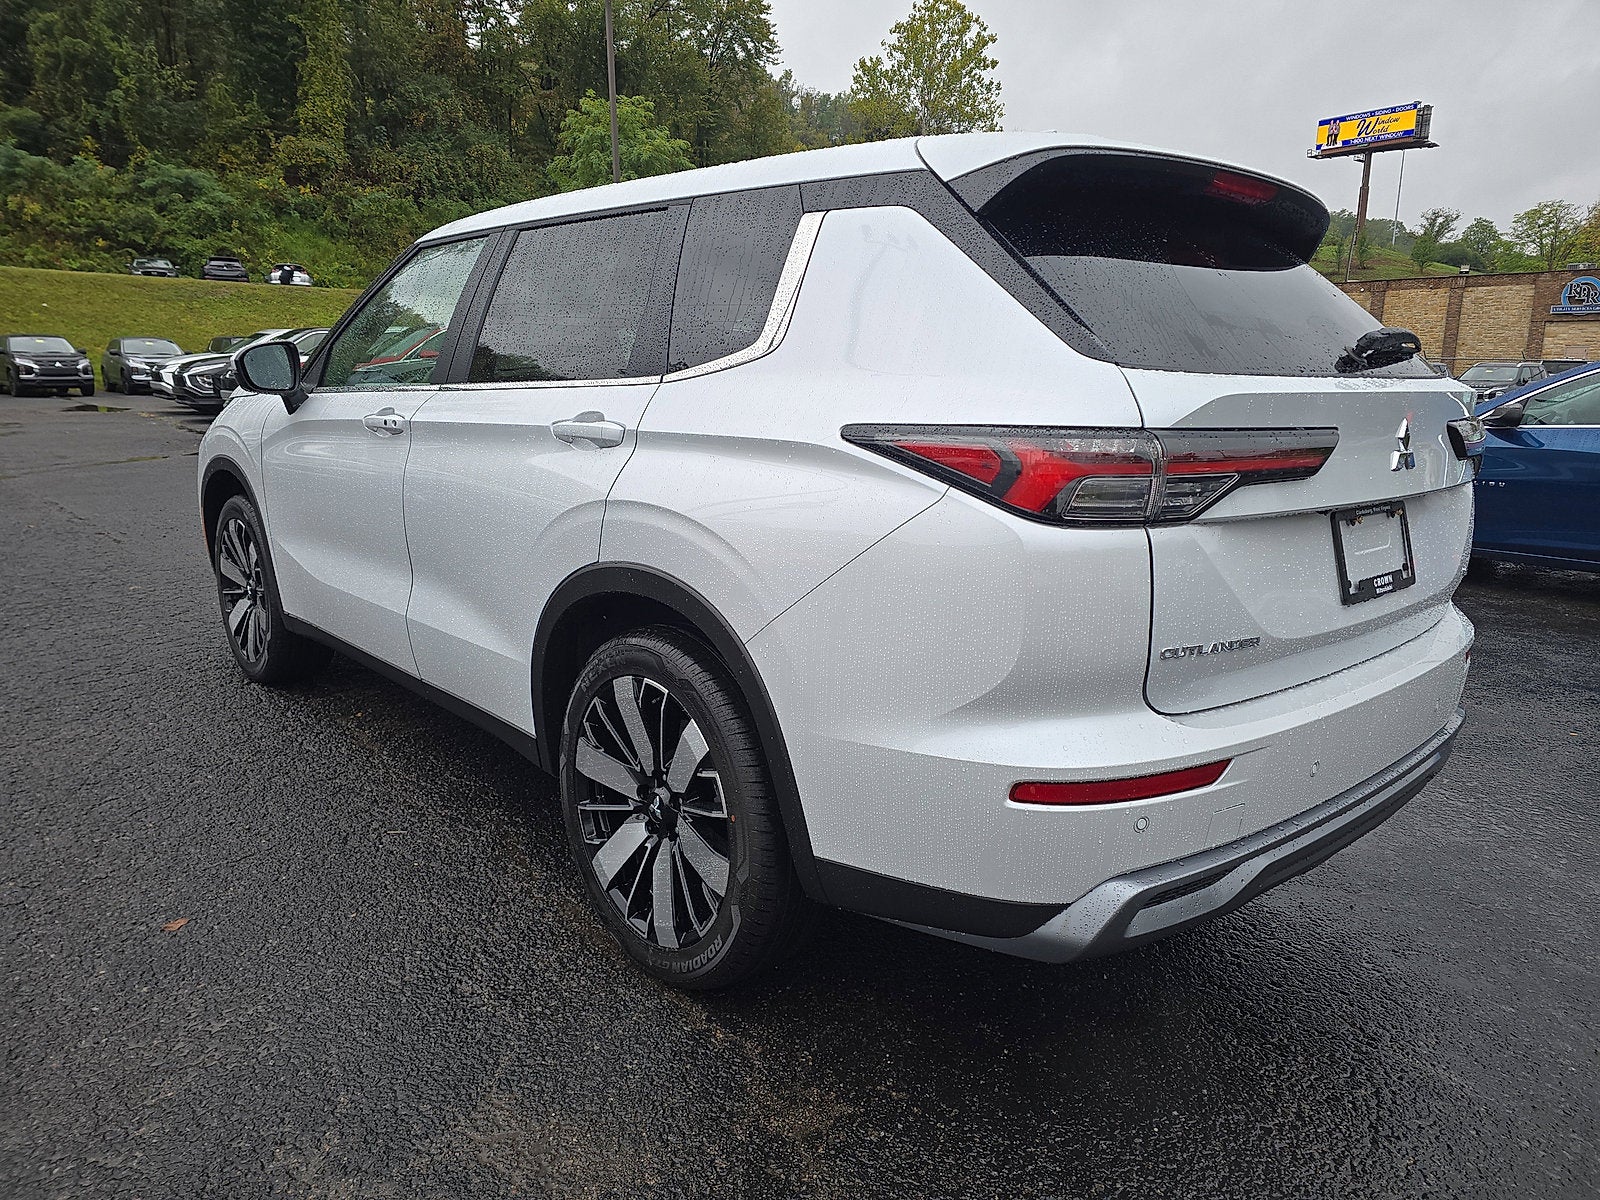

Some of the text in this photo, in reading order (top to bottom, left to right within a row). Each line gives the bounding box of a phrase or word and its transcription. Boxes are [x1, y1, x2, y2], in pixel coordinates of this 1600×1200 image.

[1346, 112, 1371, 120] WINDOWS
[1396, 104, 1415, 112] DOORS
[1356, 116, 1400, 137] Window
[1373, 575, 1393, 587] CROWN
[1160, 636, 1261, 660] OUTLANDER
[672, 933, 723, 974] ROADIAN
